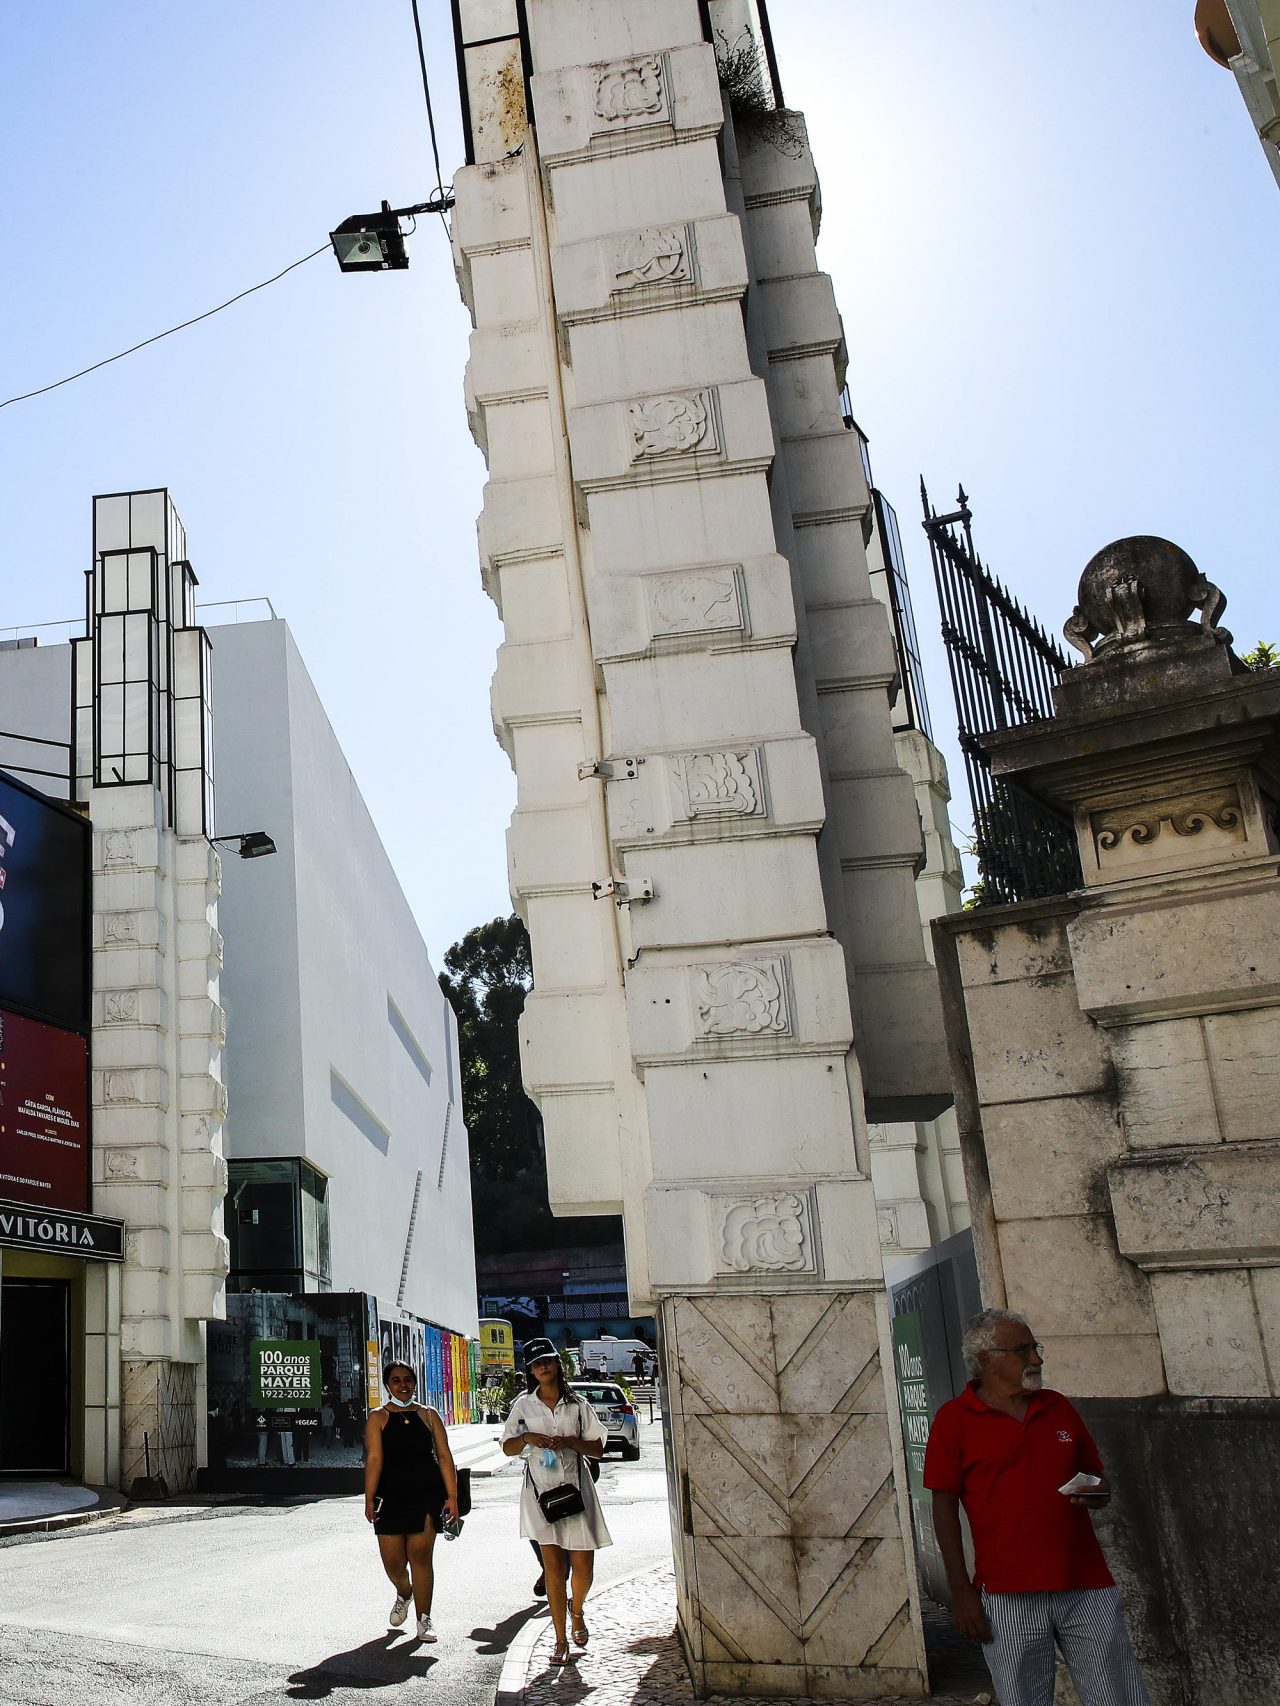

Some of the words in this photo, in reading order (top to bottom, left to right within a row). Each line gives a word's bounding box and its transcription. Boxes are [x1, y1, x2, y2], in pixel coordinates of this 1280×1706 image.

[0, 1214, 94, 1246] VITÓRIA
[259, 1351, 282, 1363] 100
[284, 1355, 310, 1363] anos
[899, 1344, 911, 1377] 100
[261, 1366, 310, 1376] PARQUE
[261, 1377, 311, 1387] MAYER
[261, 1390, 311, 1398] 1922-2022
[903, 1385, 927, 1412] PARQUE
